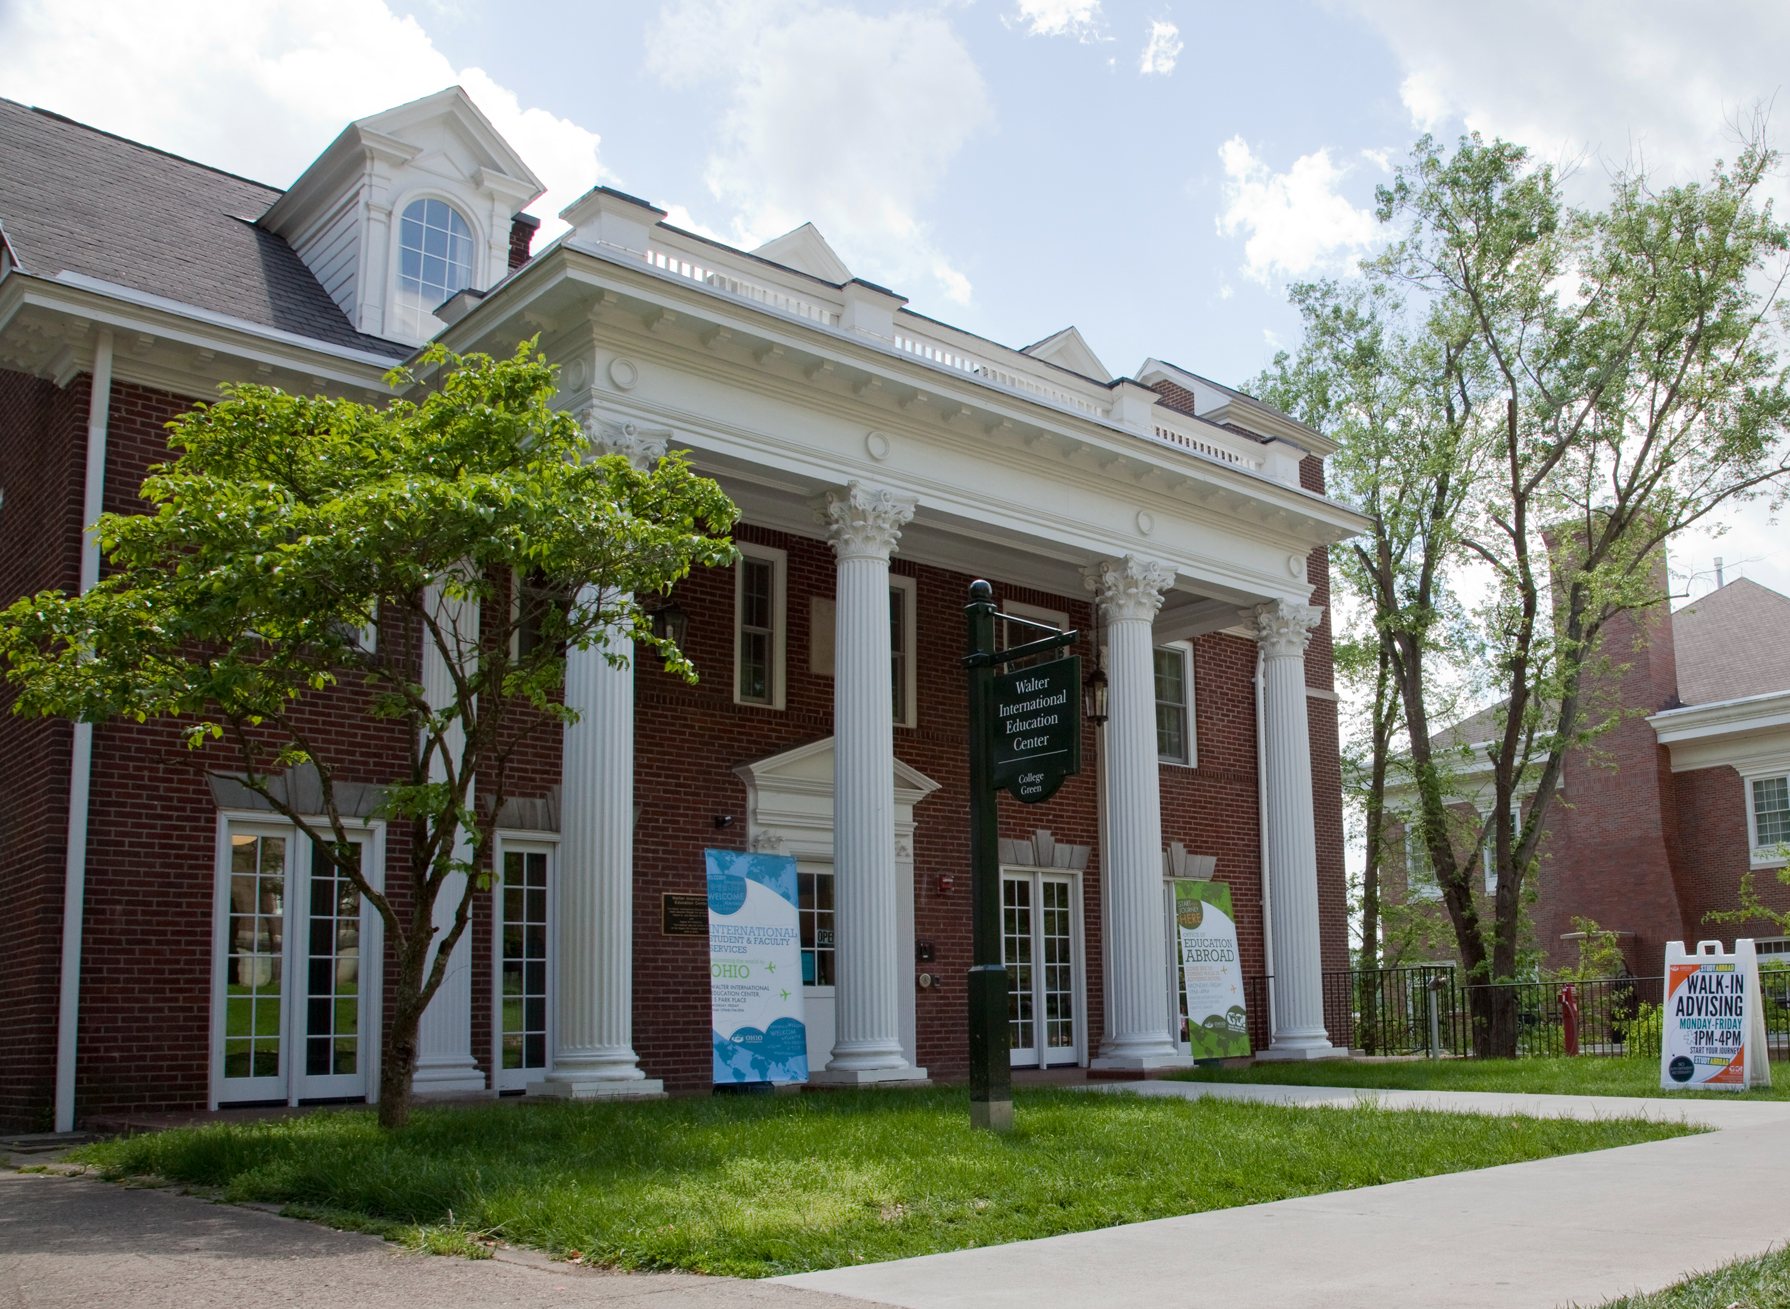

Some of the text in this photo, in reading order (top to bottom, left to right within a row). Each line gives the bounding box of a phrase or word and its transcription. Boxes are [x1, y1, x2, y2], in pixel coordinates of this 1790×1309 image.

[1016, 678, 1050, 694] Walter
[999, 689, 1066, 717] International
[1006, 714, 1058, 734] Education
[1014, 736, 1050, 751] Center
[1018, 772, 1044, 784] College
[1020, 786, 1042, 795] Green
[1179, 912, 1200, 924] HERE
[754, 938, 790, 946] FACULTY
[817, 930, 834, 943] OPE
[1184, 939, 1232, 948] EDUCATION
[1185, 949, 1234, 962] ABROAD
[711, 963, 750, 979] OHIO
[1687, 974, 1743, 994] WALK-IN
[1676, 996, 1743, 1016] ADVISING
[1680, 1018, 1742, 1030] MONDAY-FRIDAY
[1694, 1030, 1741, 1046] 1PM-4PM
